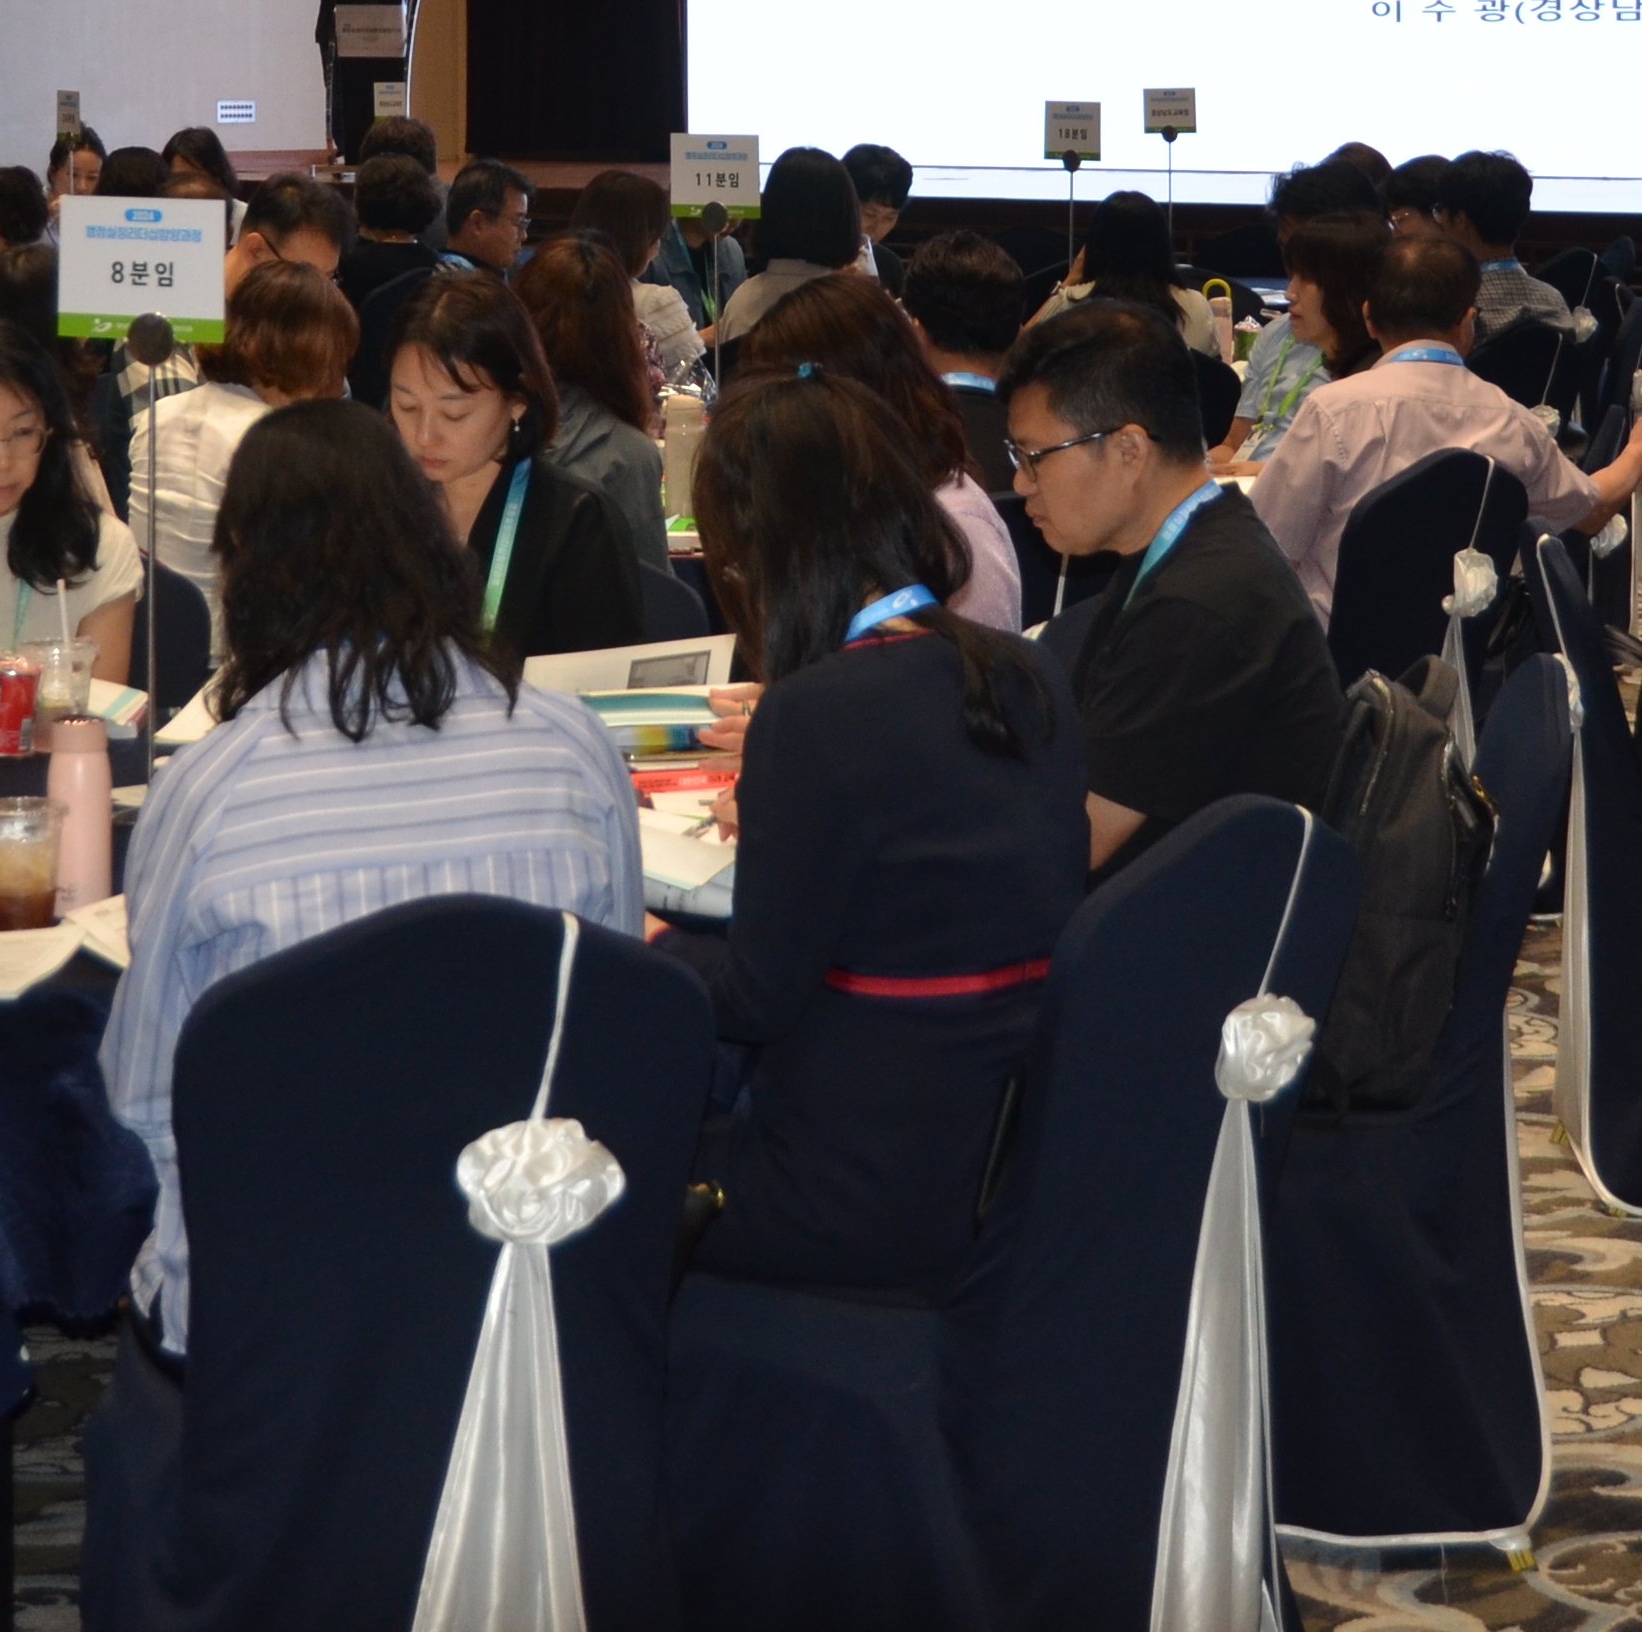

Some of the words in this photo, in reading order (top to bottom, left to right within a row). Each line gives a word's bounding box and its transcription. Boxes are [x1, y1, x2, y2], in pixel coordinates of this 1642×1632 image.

[1058, 127, 1088, 141] 18분임
[695, 172, 739, 188] 11분임
[111, 261, 174, 288] 8분임
